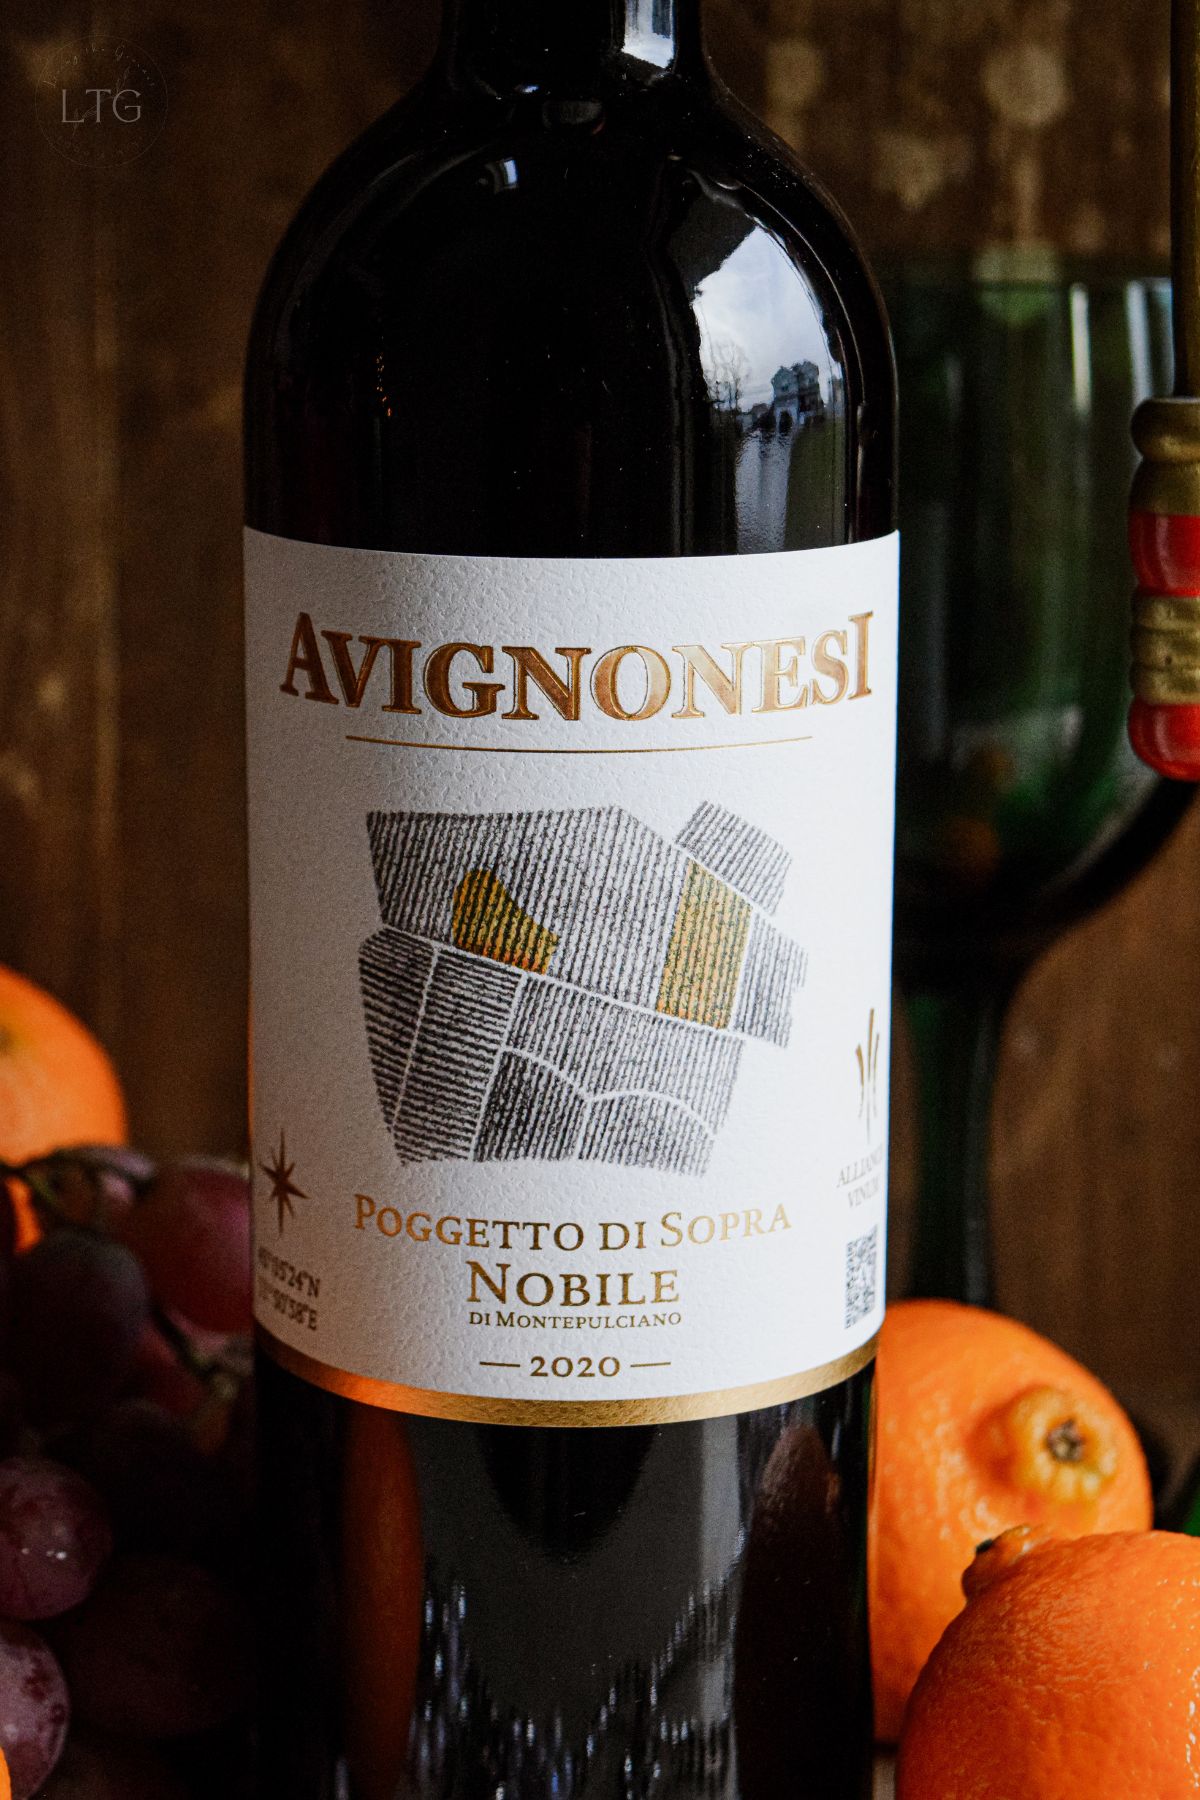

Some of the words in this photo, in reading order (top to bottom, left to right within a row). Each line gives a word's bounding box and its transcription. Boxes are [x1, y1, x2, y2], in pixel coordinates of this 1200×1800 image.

[280, 612, 874, 721] AVIGNONESI
[354, 1194, 584, 1251] POGGETTO
[599, 1221, 645, 1250] DI
[660, 1203, 792, 1247] SOPRA
[466, 1260, 680, 1306] NOBILE
[469, 1311, 491, 1326] DI
[496, 1311, 682, 1329] MONTEPULCIANO
[530, 1356, 621, 1377] 2020
